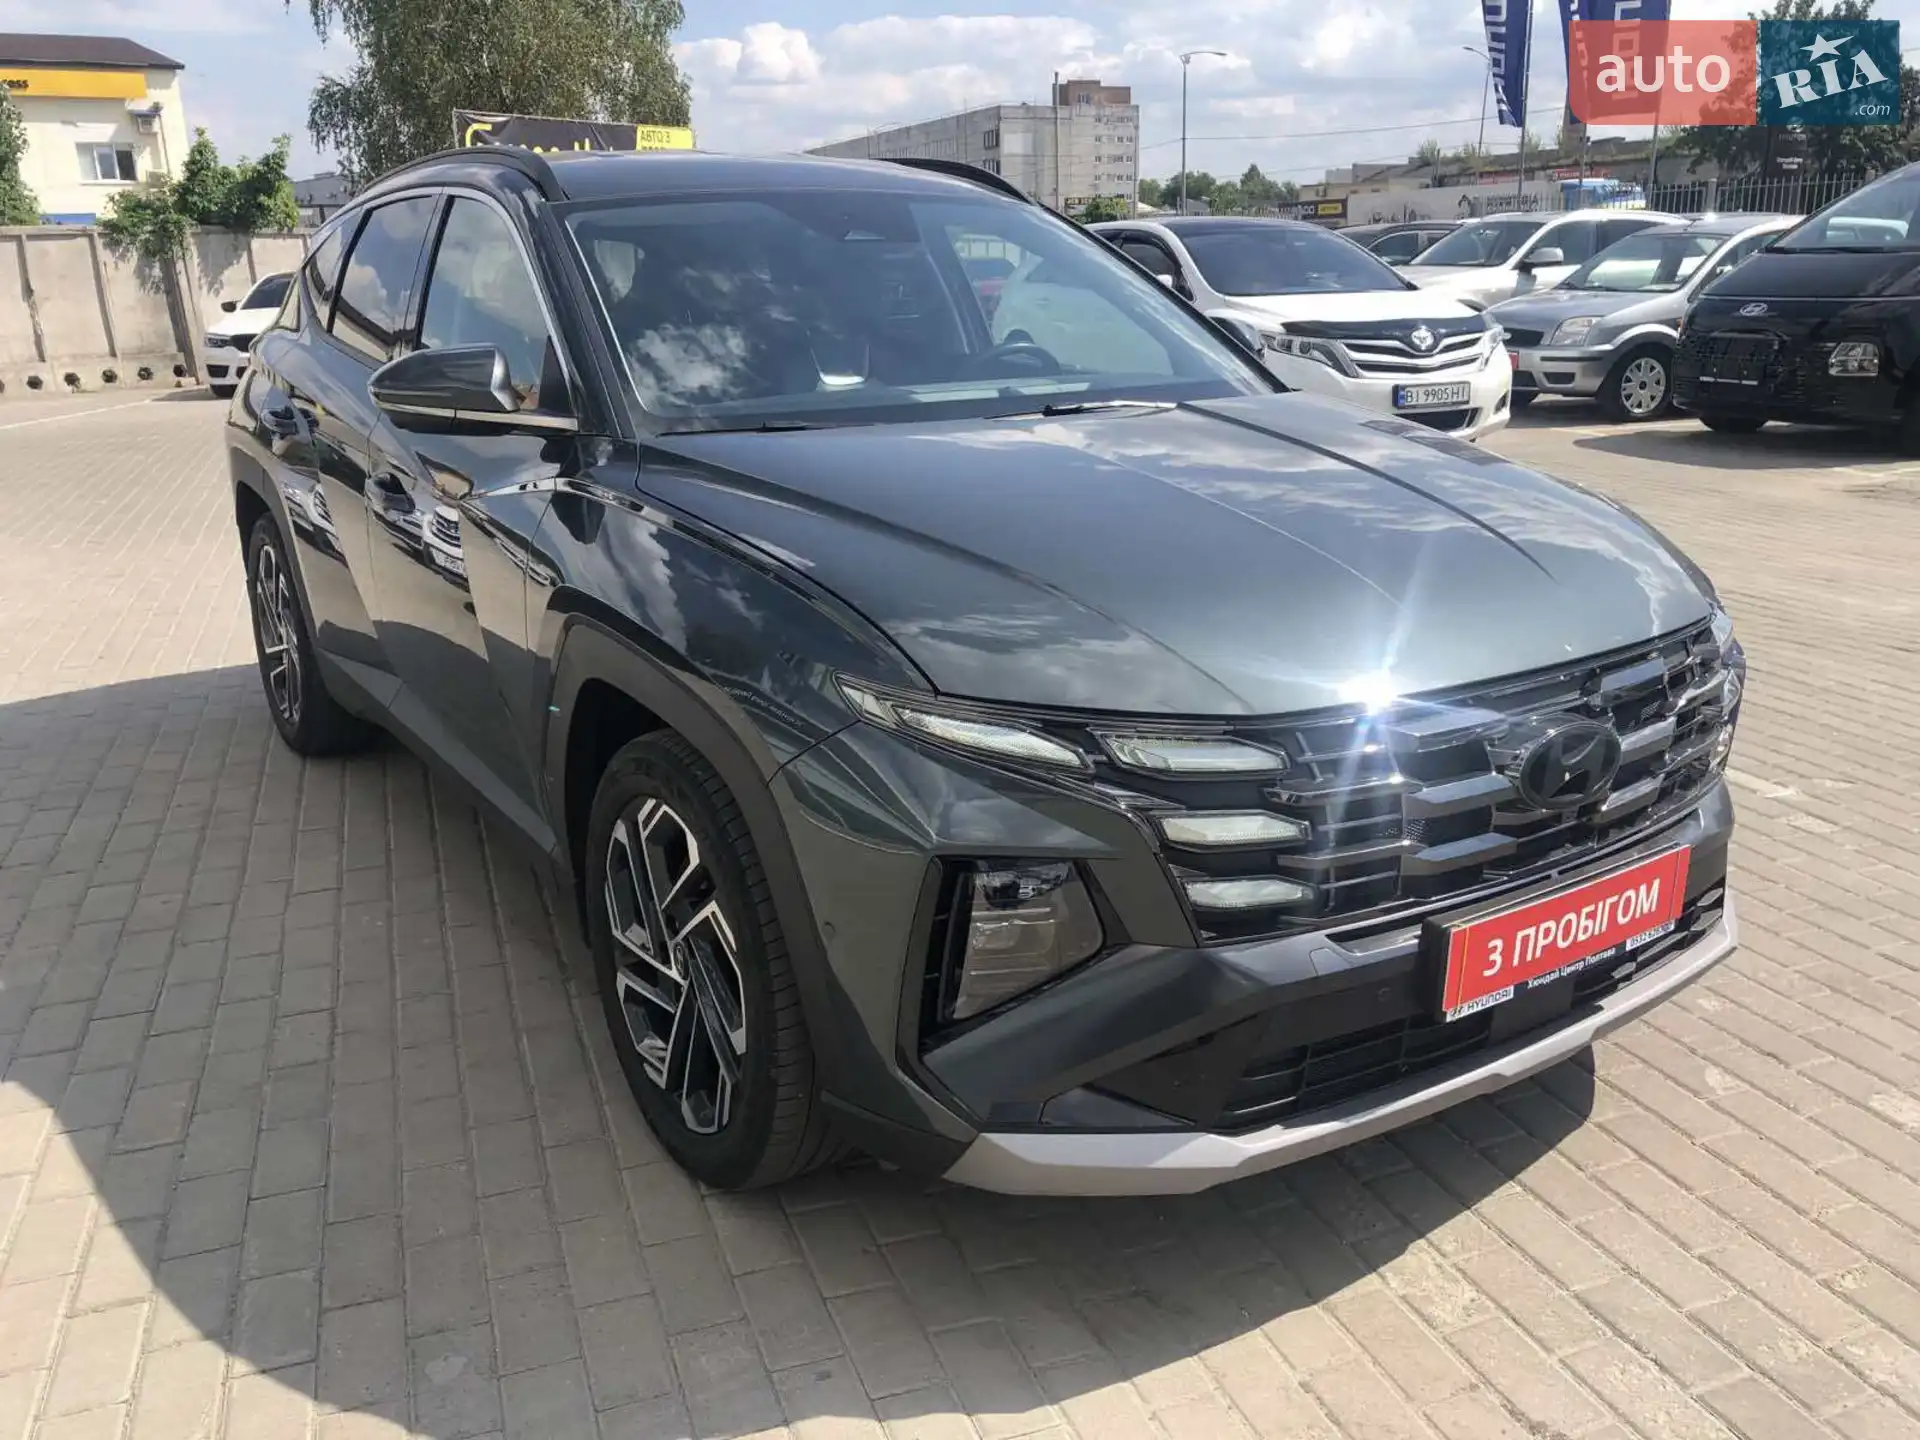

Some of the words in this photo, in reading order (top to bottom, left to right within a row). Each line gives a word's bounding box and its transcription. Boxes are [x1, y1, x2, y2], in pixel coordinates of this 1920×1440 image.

[1482, 939, 1503, 977] З
[1512, 877, 1661, 968] ПРОБІГОМ
[1560, 958, 1585, 979] Центр
[1585, 946, 1616, 970] Полтава
[1466, 986, 1513, 1012] HYUNDAI
